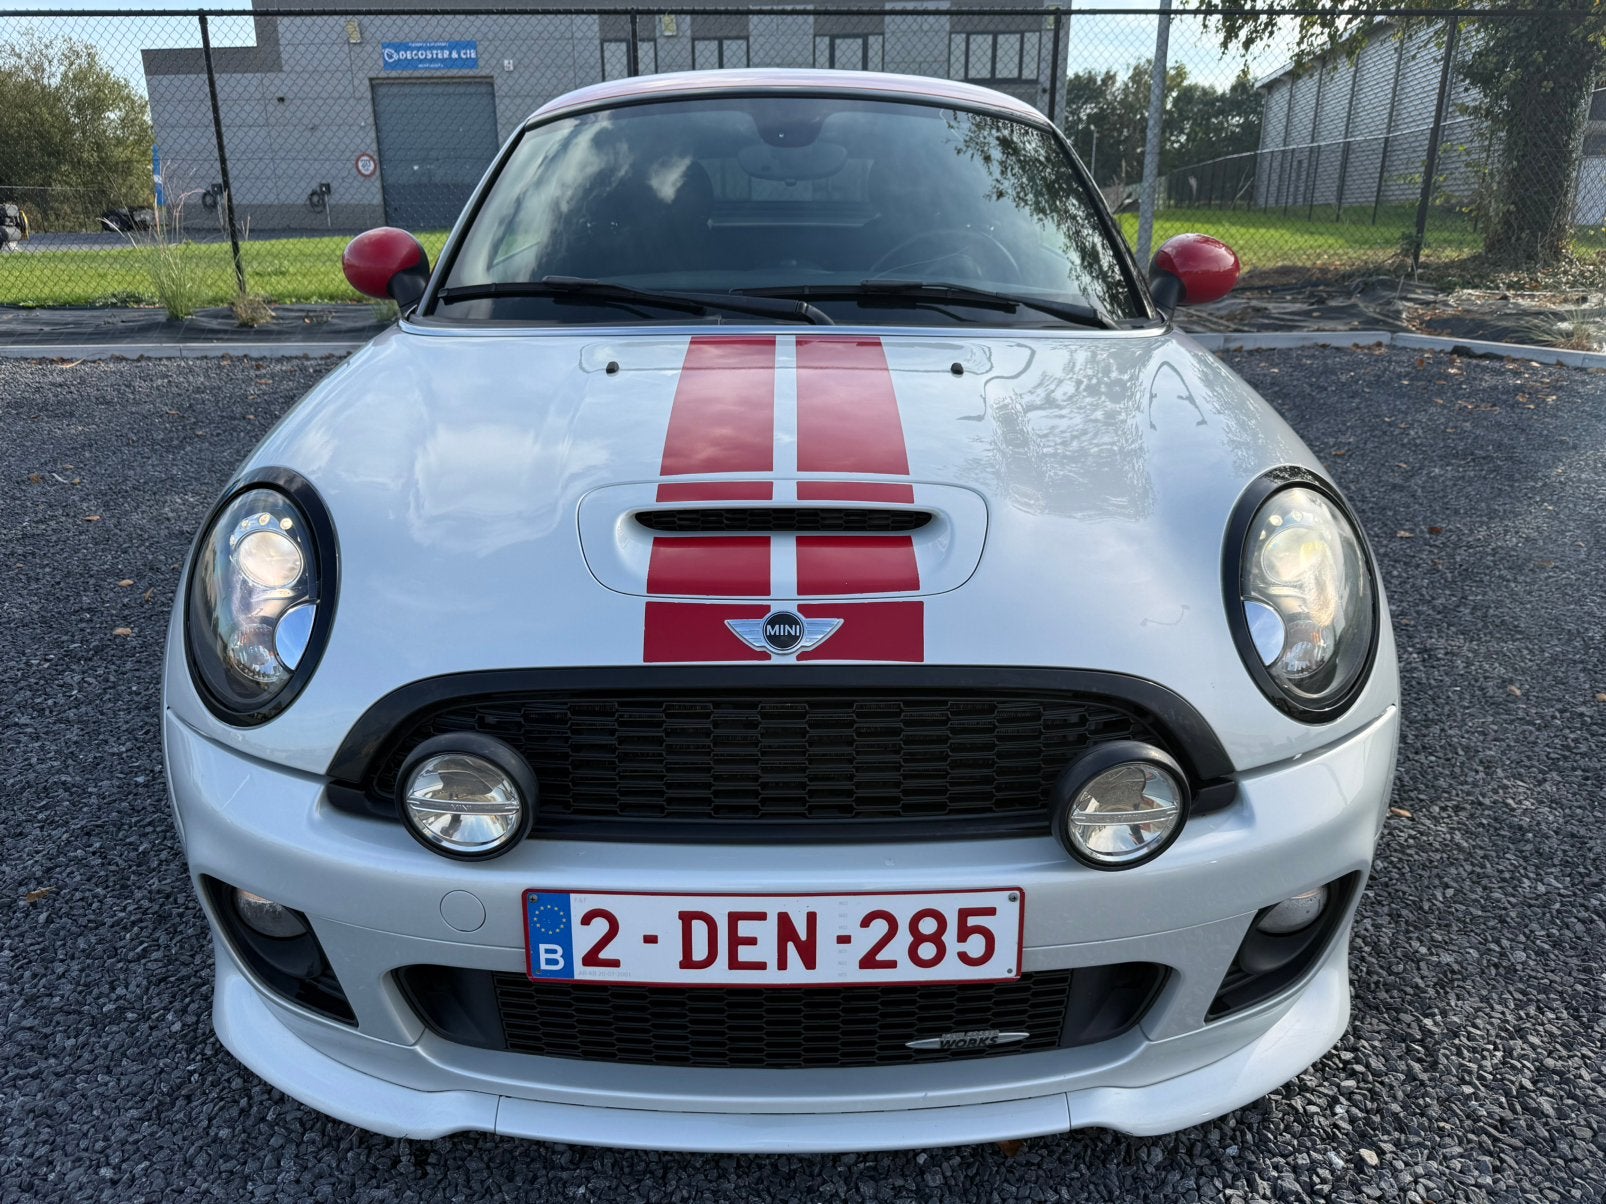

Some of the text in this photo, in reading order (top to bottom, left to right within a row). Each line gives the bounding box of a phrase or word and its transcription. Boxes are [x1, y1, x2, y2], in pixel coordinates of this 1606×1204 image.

[400, 49, 476, 59] DECOSTER & CIE
[766, 624, 800, 636] MINI
[538, 943, 565, 971] B
[940, 1035, 999, 1049] WORKS
